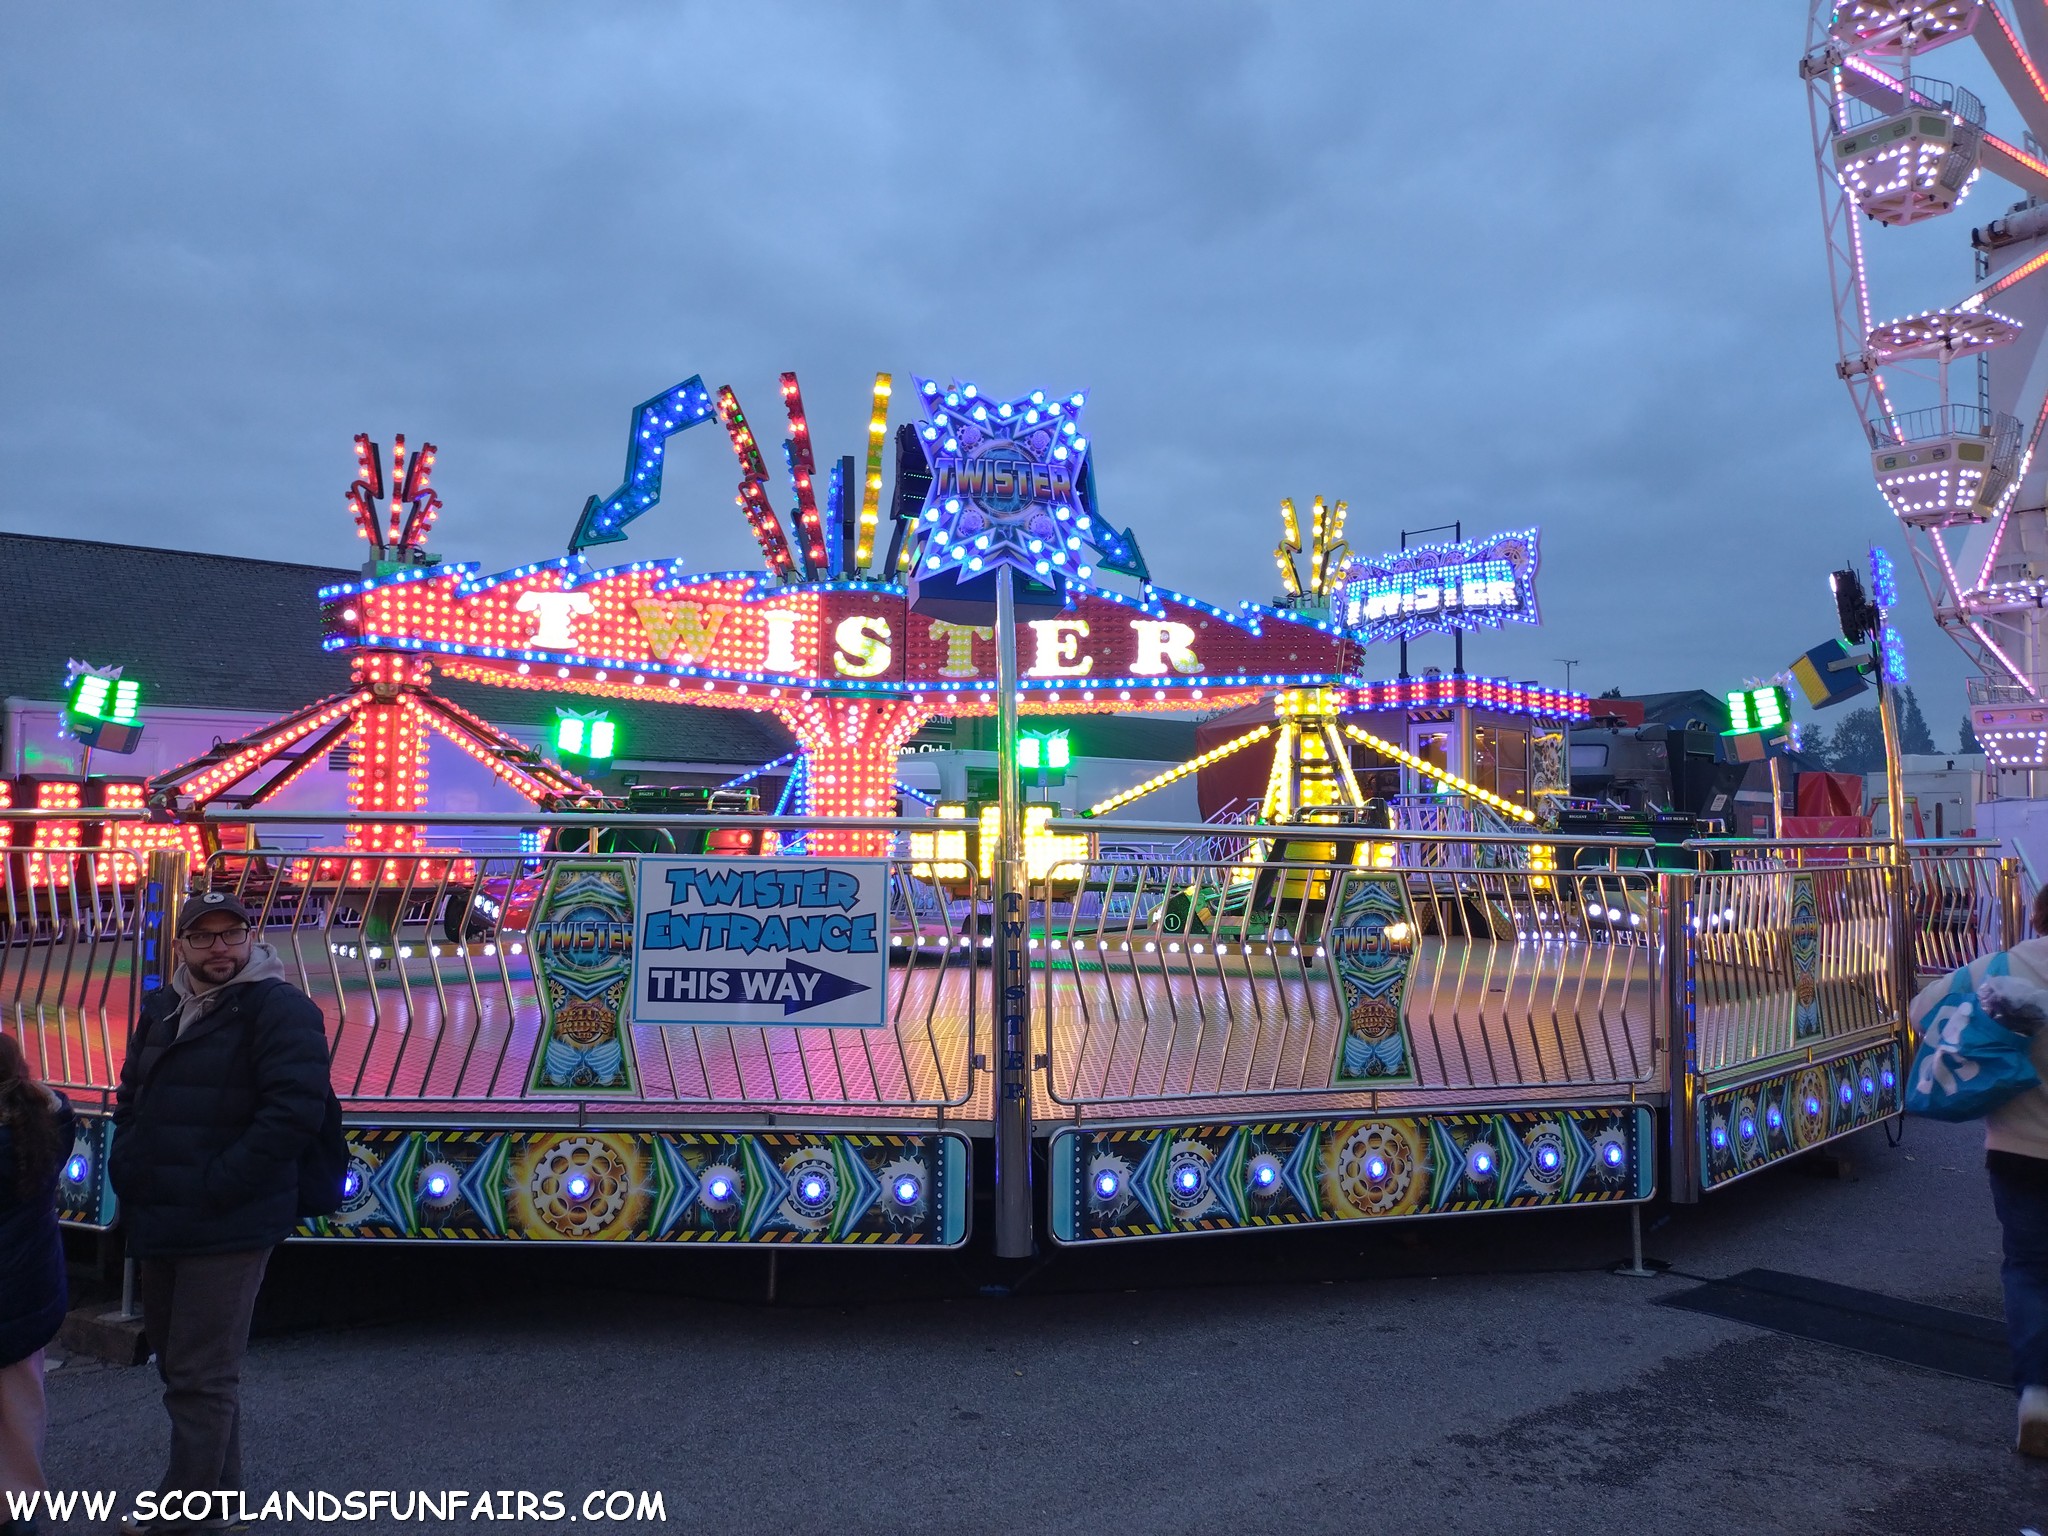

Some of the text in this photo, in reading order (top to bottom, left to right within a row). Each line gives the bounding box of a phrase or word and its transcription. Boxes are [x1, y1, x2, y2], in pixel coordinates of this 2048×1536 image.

[934, 457, 1071, 503] TWISTER
[1346, 559, 1519, 626] TWISTER
[515, 590, 1205, 679] TWISTER
[666, 867, 861, 911] TWISTER
[642, 909, 879, 955] ENTRANCE
[651, 968, 822, 1002] THIS WAY
